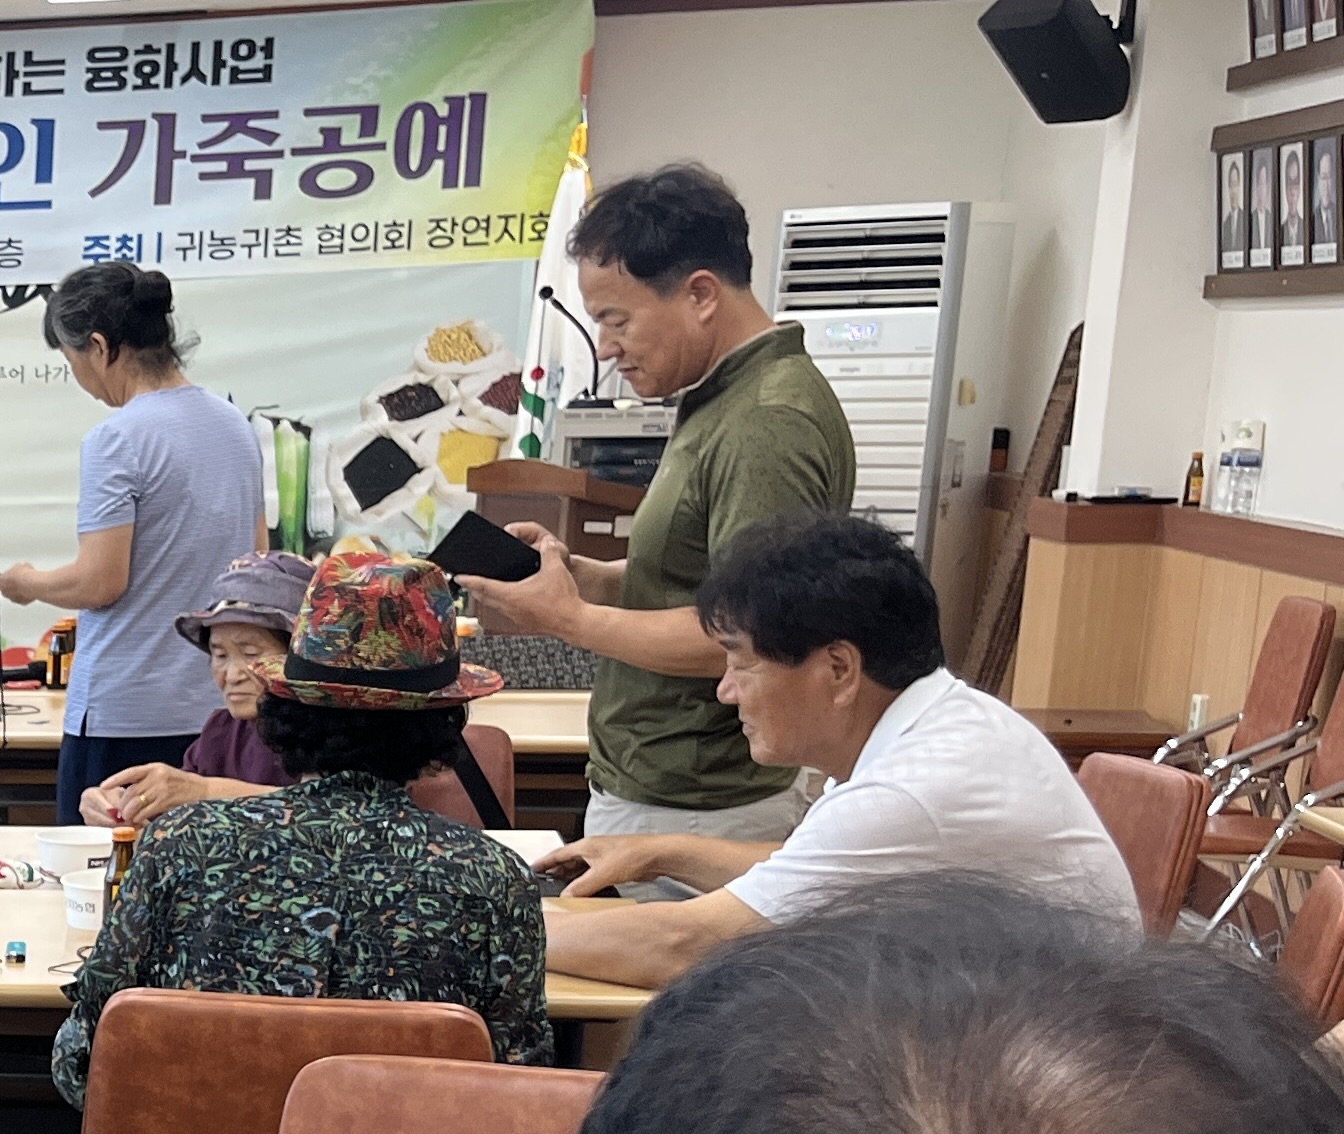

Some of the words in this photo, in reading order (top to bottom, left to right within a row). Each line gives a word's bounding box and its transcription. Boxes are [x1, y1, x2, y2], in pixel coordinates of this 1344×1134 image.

[84, 37, 276, 92] 융화사업
[87, 90, 488, 208] 가죽공예
[81, 233, 144, 264] 주최
[174, 225, 305, 262] 귀농귀촌
[316, 219, 414, 256] 협의회
